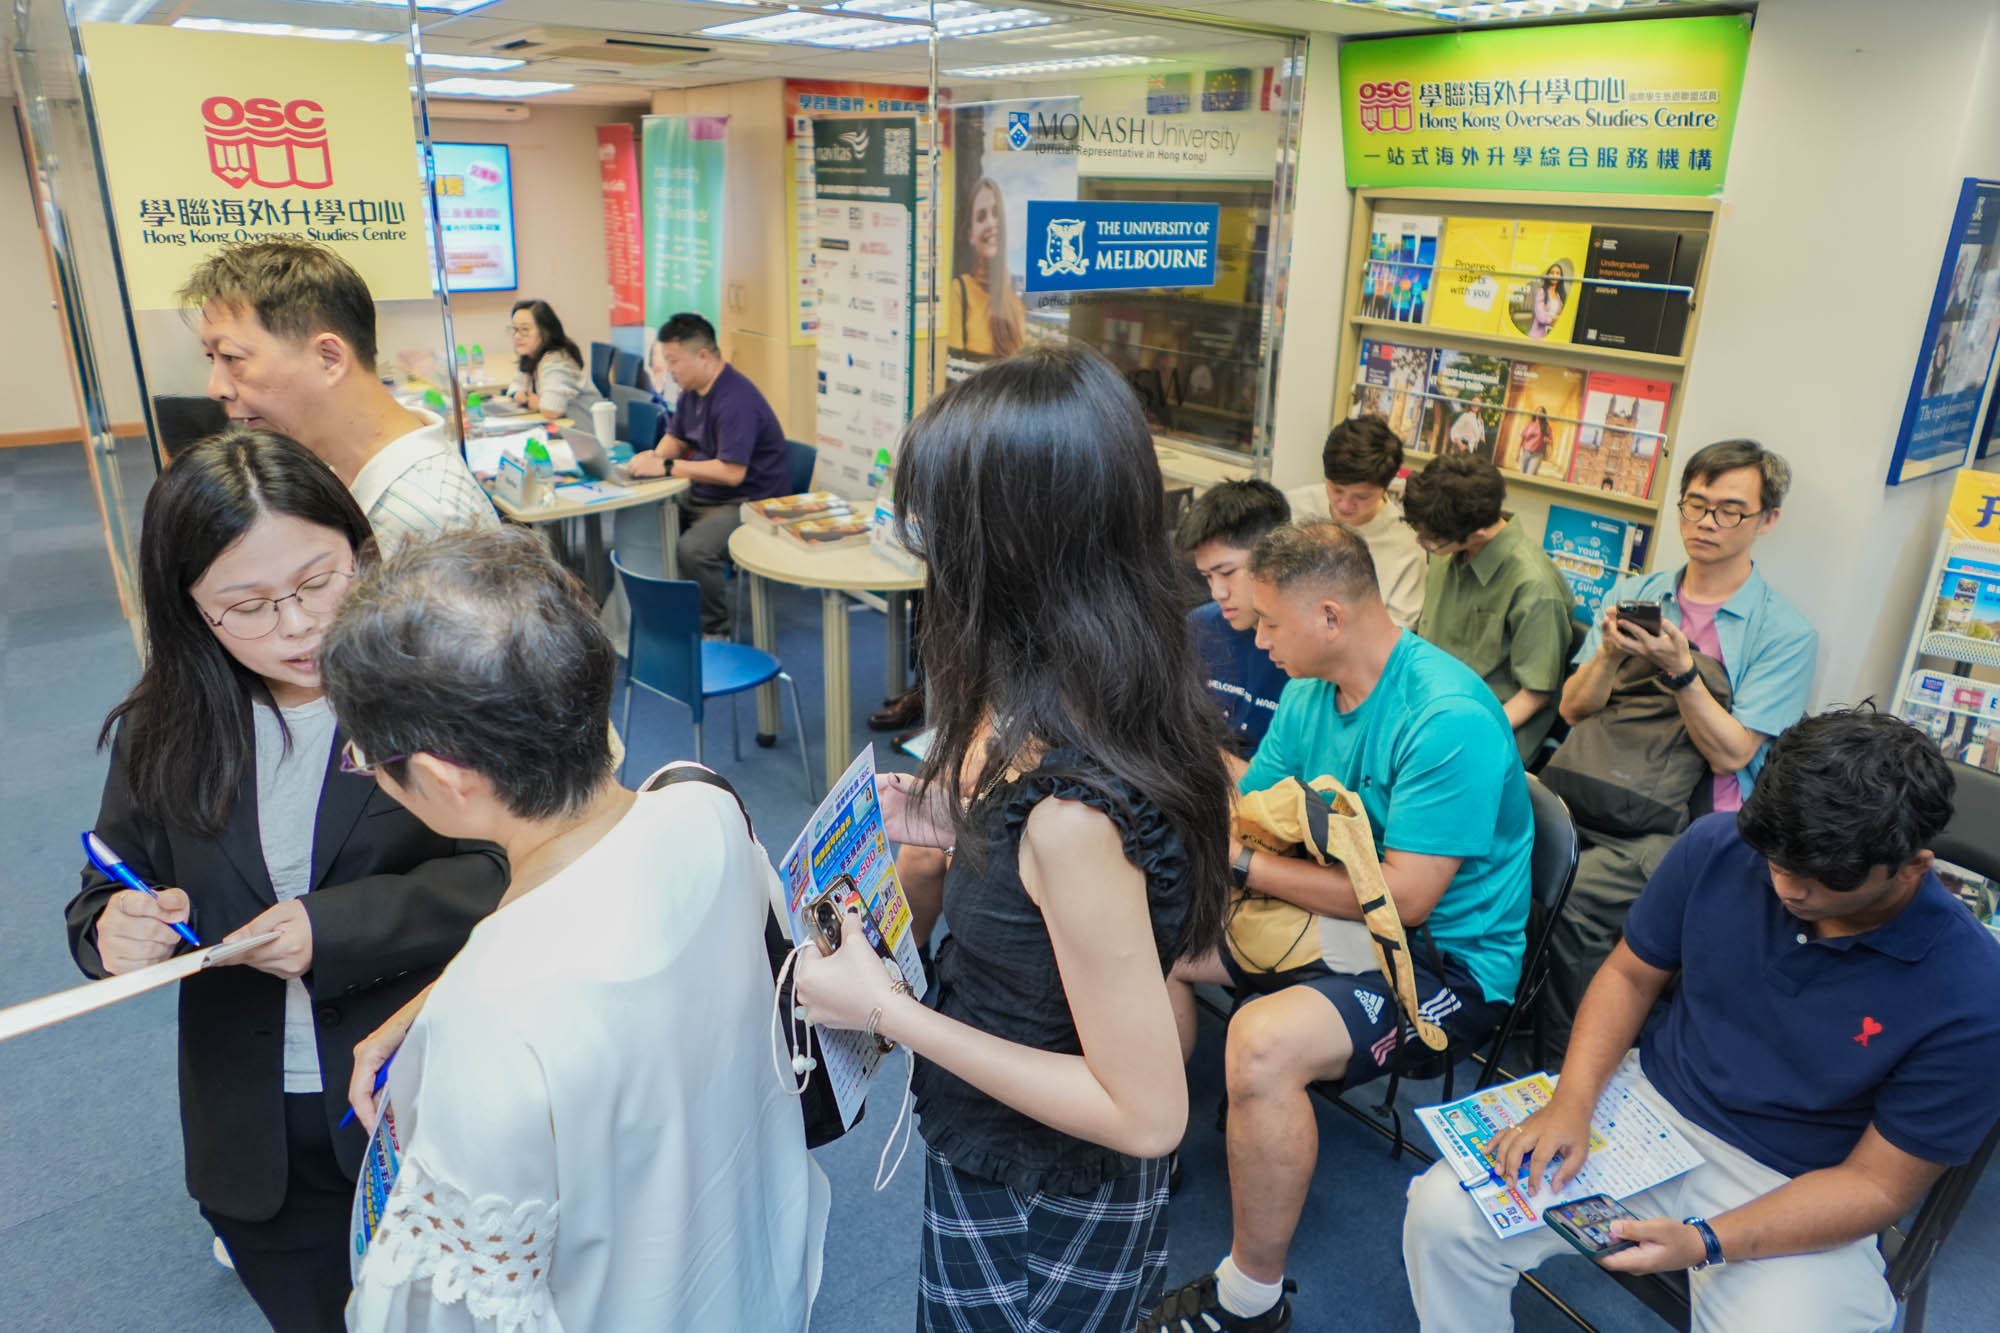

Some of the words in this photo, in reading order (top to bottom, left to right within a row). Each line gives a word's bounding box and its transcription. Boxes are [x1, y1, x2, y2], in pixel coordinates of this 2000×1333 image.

[1359, 81, 1411, 99] OSC
[1419, 77, 1625, 107] 學聯海外升學中心
[201, 96, 325, 129] OSC
[1419, 111, 1458, 131] Hong
[1462, 110, 1500, 131] Kong
[1505, 109, 1580, 128] Overseas
[1585, 107, 1649, 127] Studies
[1654, 107, 1717, 128] Centre
[1036, 111, 1146, 145] MONASH
[1150, 119, 1241, 156] University
[1077, 145, 1146, 159] Representative
[1147, 150, 1156, 159] in
[1157, 150, 1181, 162] Hong
[1182, 152, 1208, 163] Kong)
[1364, 146, 1713, 171] 一站式海外升學綜合服務機構
[140, 198, 406, 228] 學聯海外升學中心
[143, 229, 187, 247] Hong
[190, 229, 230, 244] Kong
[306, 227, 359, 242] Studies
[362, 227, 408, 242] Centre
[1096, 221, 1121, 235] THE
[1123, 221, 1193, 235] UNIVERSITY
[1194, 221, 1211, 236] OF
[1095, 248, 1208, 271] MELBOURNE
[1455, 259, 1497, 274] Progress
[1600, 259, 1651, 271] Undergraduate
[1458, 275, 1488, 286] starts
[1599, 269, 1641, 280] International
[1450, 286, 1471, 297] with
[1473, 289, 1492, 300] you
[1578, 546, 1601, 558] YOUR
[1577, 582, 1604, 597] GUIDE
[1353, 988, 1378, 1025] adidas
